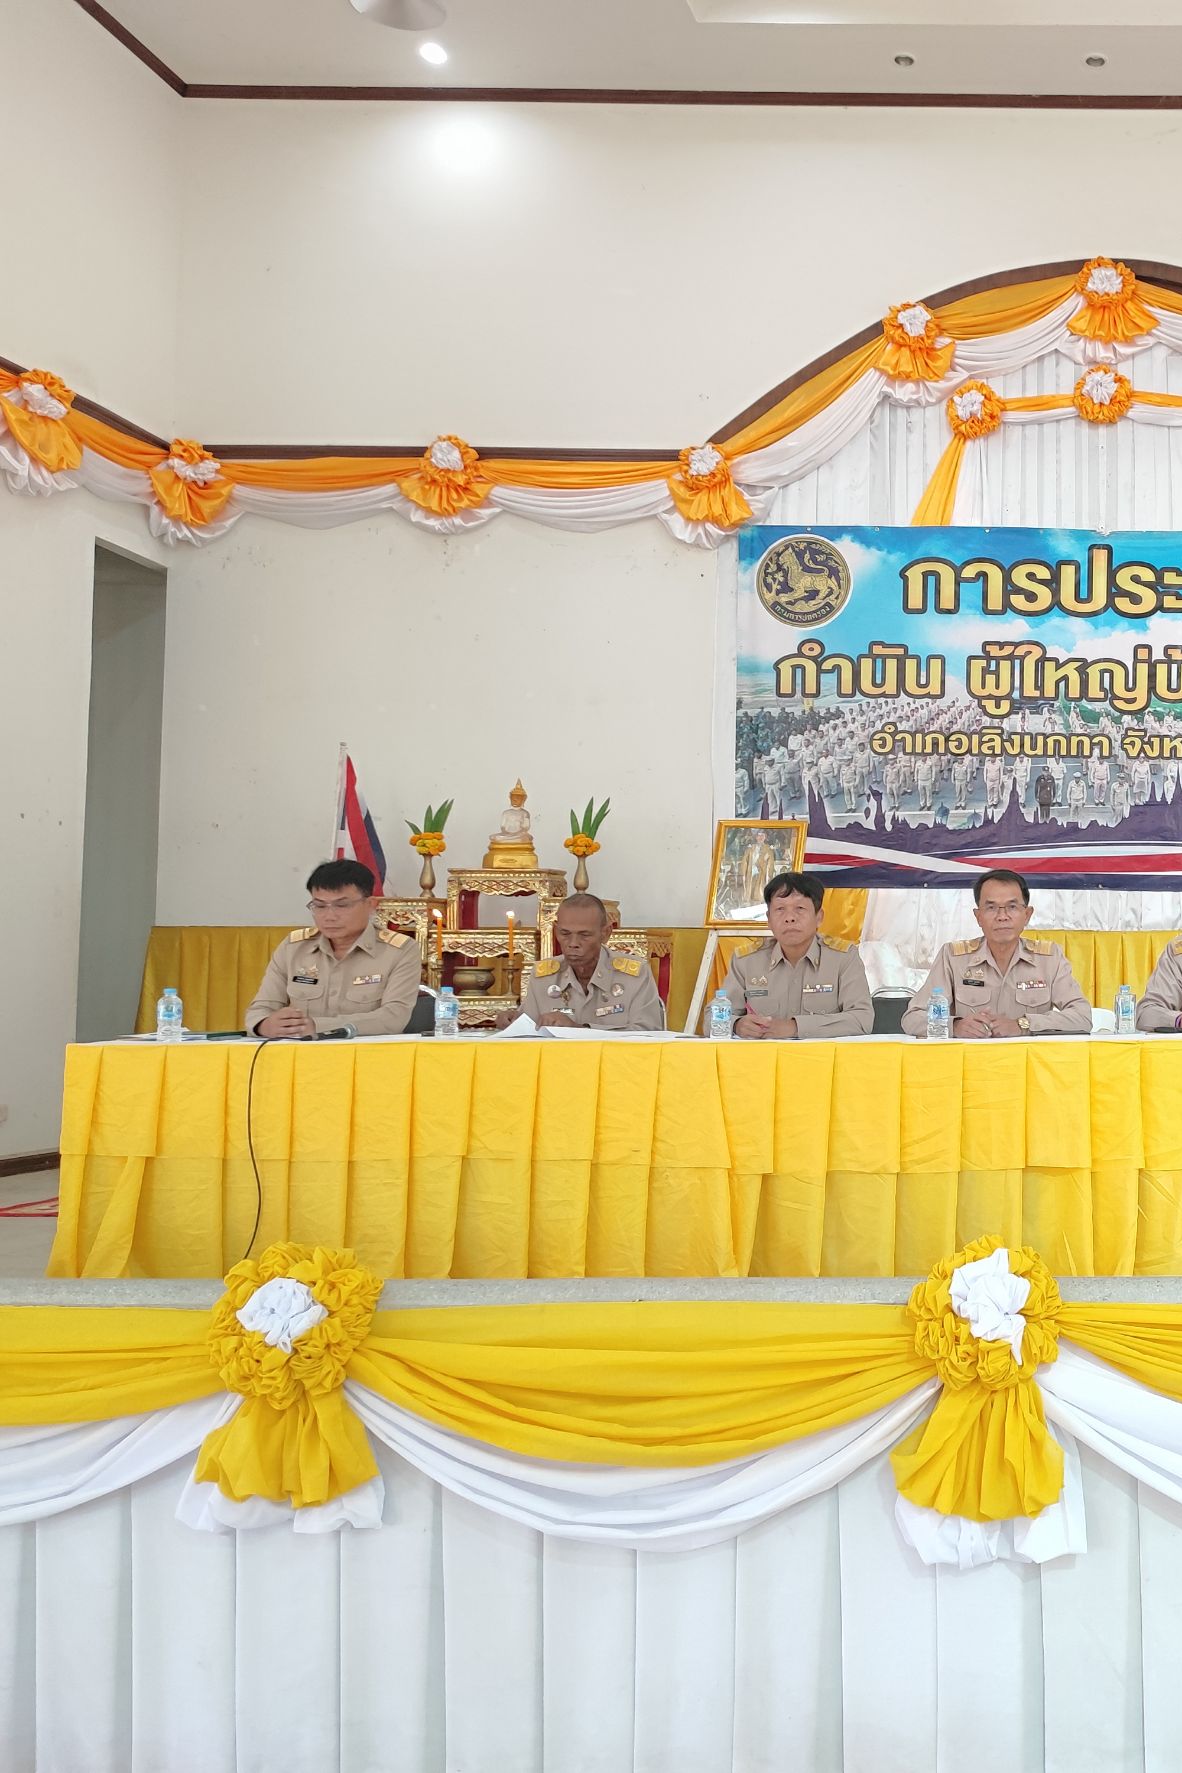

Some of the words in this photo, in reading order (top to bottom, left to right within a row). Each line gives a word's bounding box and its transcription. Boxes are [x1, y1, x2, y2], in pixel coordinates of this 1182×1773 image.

[773, 638, 946, 698] กำนัน
[870, 722, 1112, 759] อำเภอเลิงนกทา
